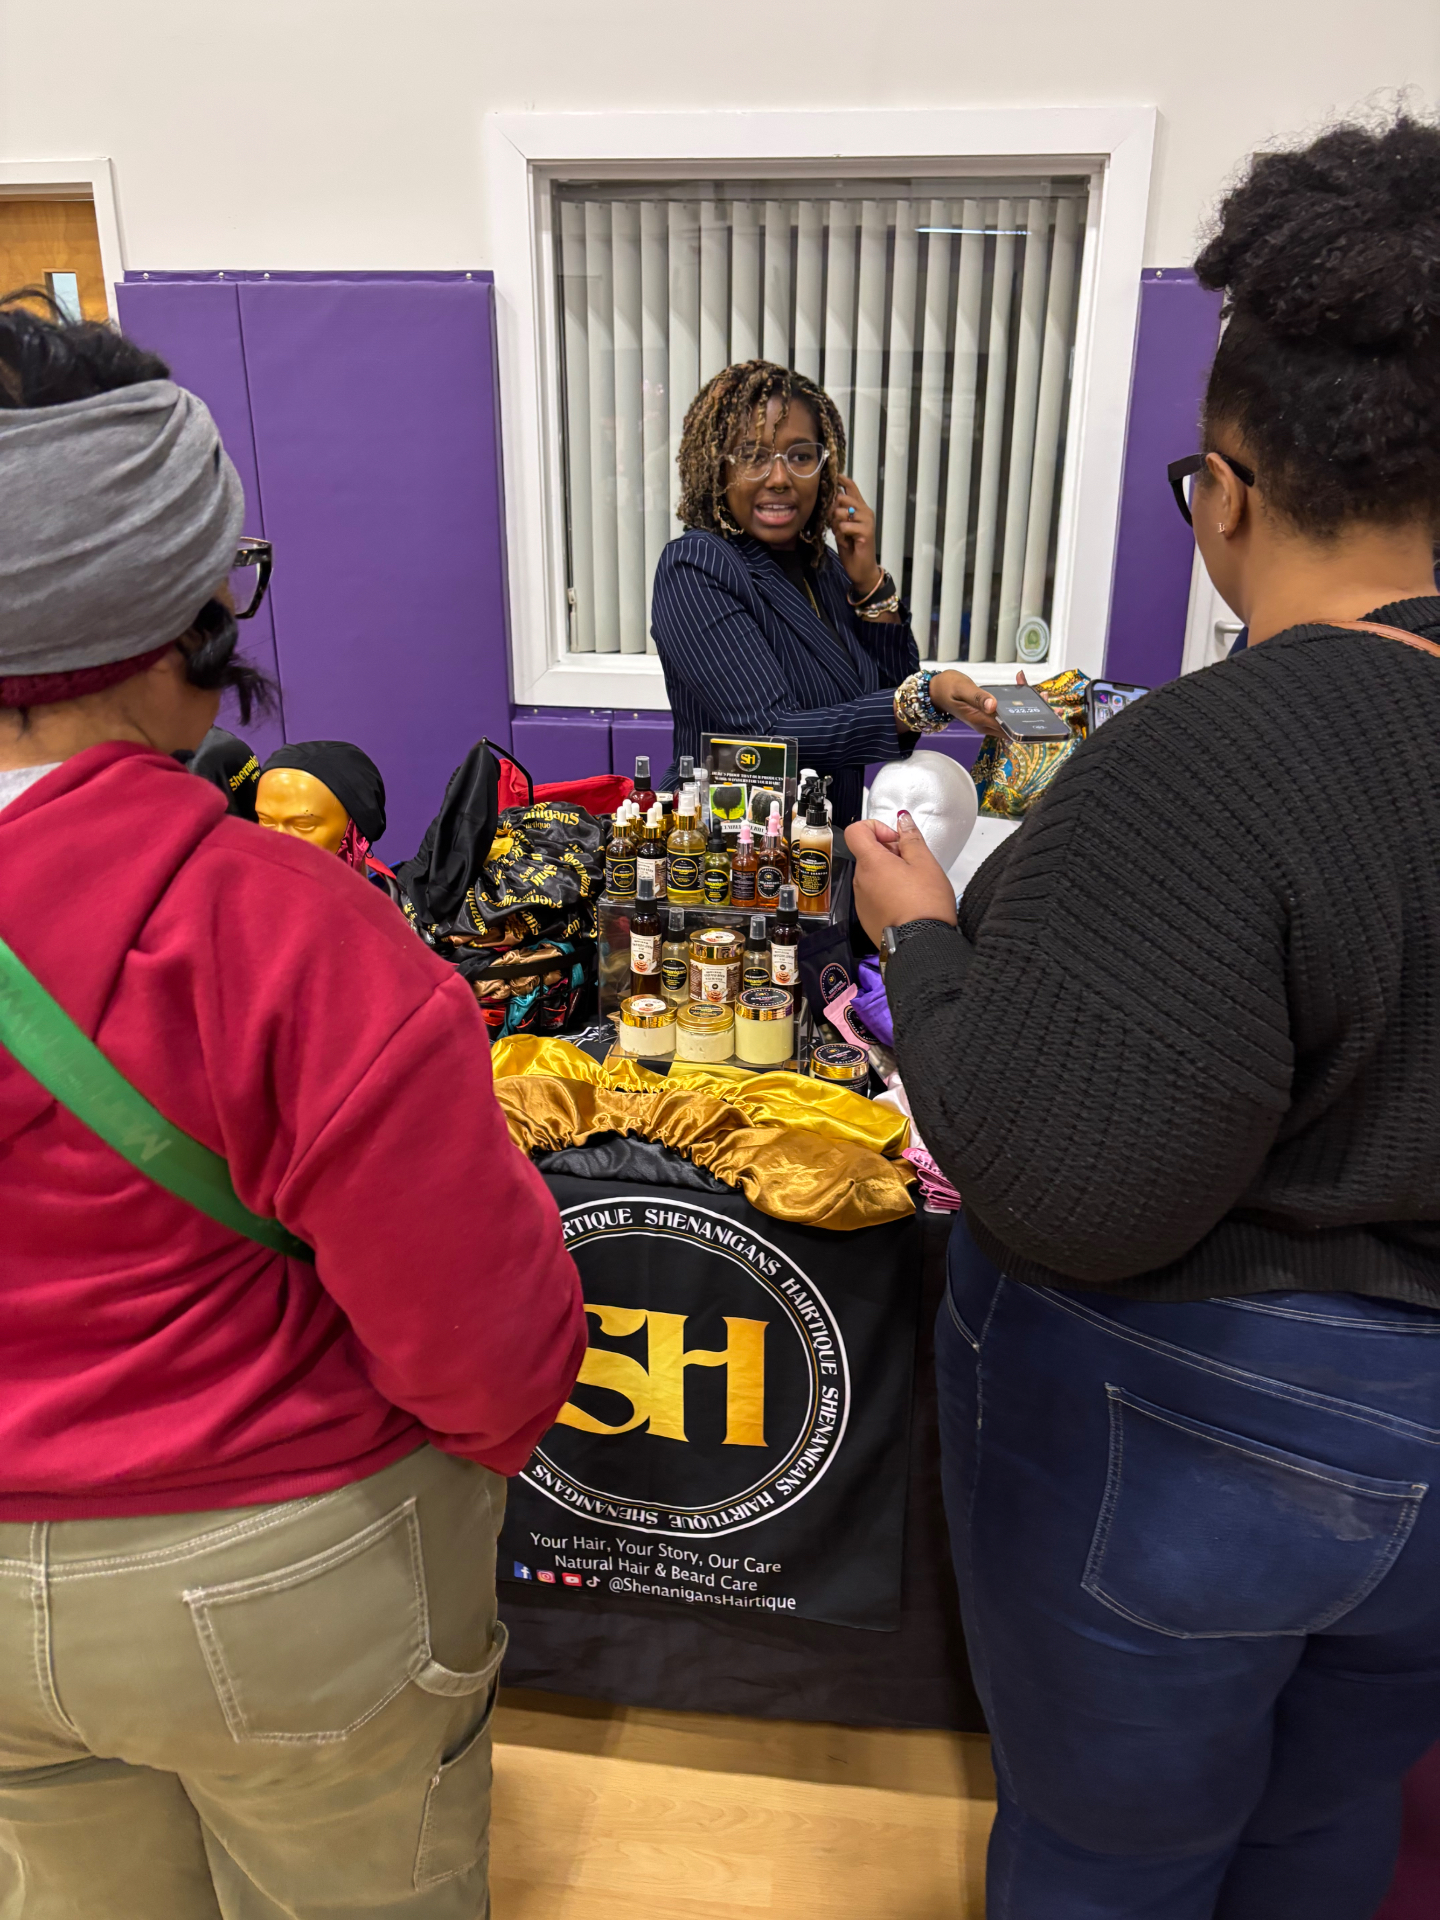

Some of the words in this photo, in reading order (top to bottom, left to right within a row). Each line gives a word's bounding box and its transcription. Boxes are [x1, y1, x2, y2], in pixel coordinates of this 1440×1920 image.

[644, 1208, 782, 1276] SHENANIGANS
[780, 1277, 838, 1375] HAIRTIQUE
[554, 1303, 770, 1447] SH
[775, 1385, 839, 1496] SHENANIGANS
[532, 1463, 658, 1526] SHENANIGANS
[530, 1532, 568, 1550] Your
[574, 1536, 611, 1553] Hair,
[616, 1538, 654, 1557] Your
[659, 1543, 703, 1567] Story,
[708, 1554, 739, 1570] Our
[744, 1558, 782, 1574] Care
[555, 1555, 613, 1571] Natural
[618, 1559, 650, 1576] Hair
[654, 1563, 667, 1578] &
[672, 1566, 715, 1587] Beard
[720, 1576, 758, 1591] Care
[609, 1577, 796, 1611] @ShenanigansHairtique
